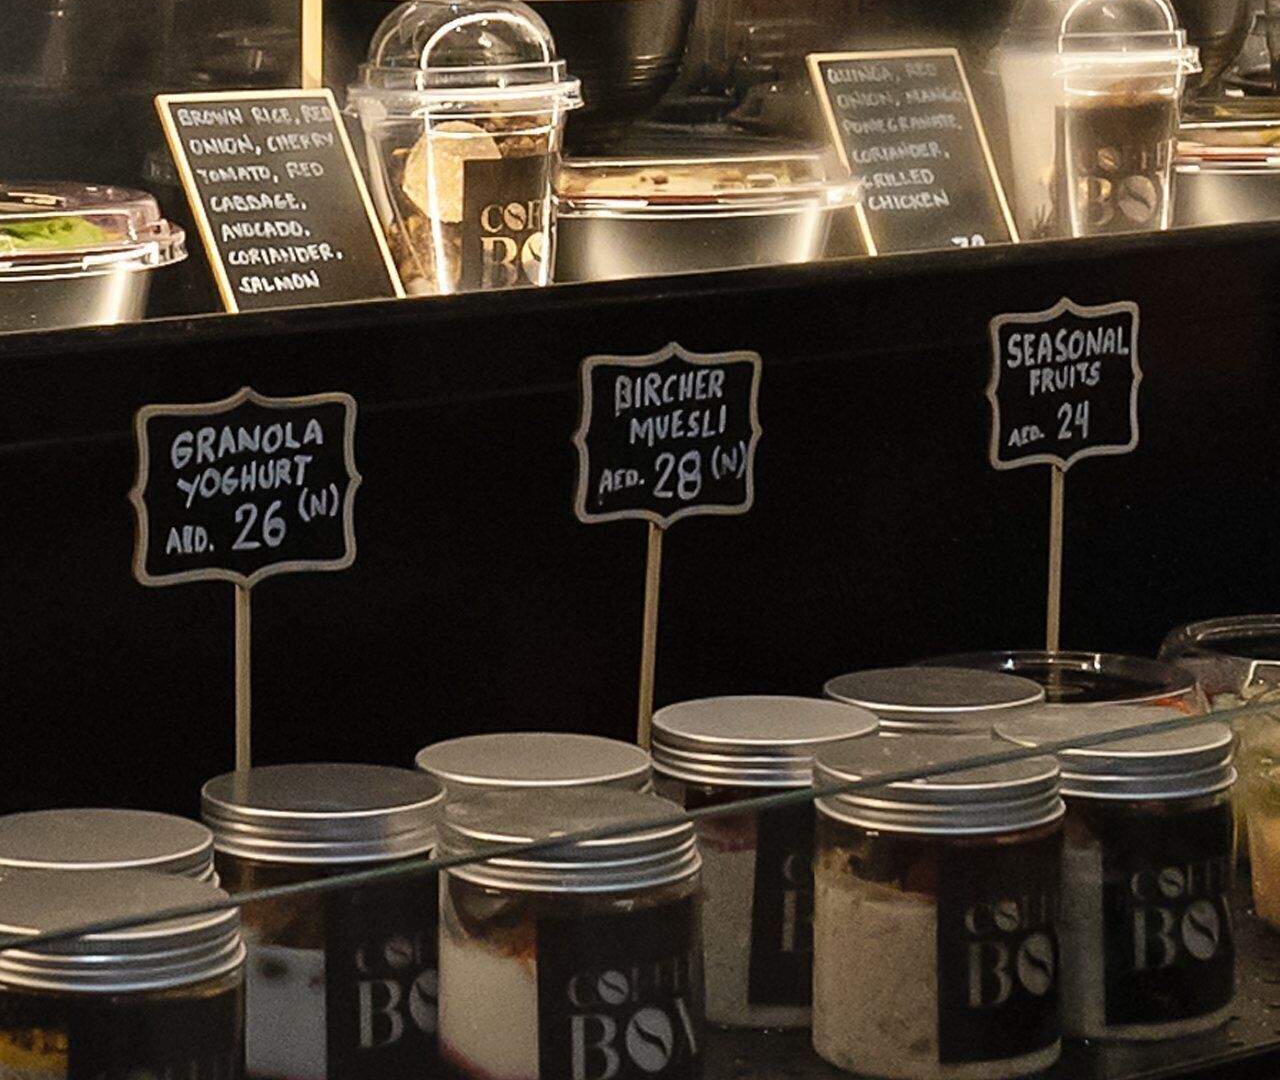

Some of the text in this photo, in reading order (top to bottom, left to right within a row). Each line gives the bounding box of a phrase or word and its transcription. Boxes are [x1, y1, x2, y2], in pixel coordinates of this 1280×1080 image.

[177, 107, 243, 126] BROWN
[301, 104, 334, 123] RED
[189, 132, 334, 156] ONION, CHERRY
[196, 161, 323, 184] TOMATO, RED
[861, 168, 935, 188] GRILLED
[868, 189, 950, 210] CHICKEN
[239, 270, 320, 294] SALMON
[1007, 325, 1130, 368] SEASONAL
[614, 370, 725, 414] BIRCHER
[1029, 361, 1102, 397] FRUITS
[171, 419, 323, 469] GRANOLA
[628, 405, 727, 448] MUESLI
[1008, 400, 1090, 447] AED. 24
[177, 455, 313, 509] YOGHURT
[599, 440, 748, 500] AED. 28 (N)
[166, 483, 339, 555] AED. 26 (N)
